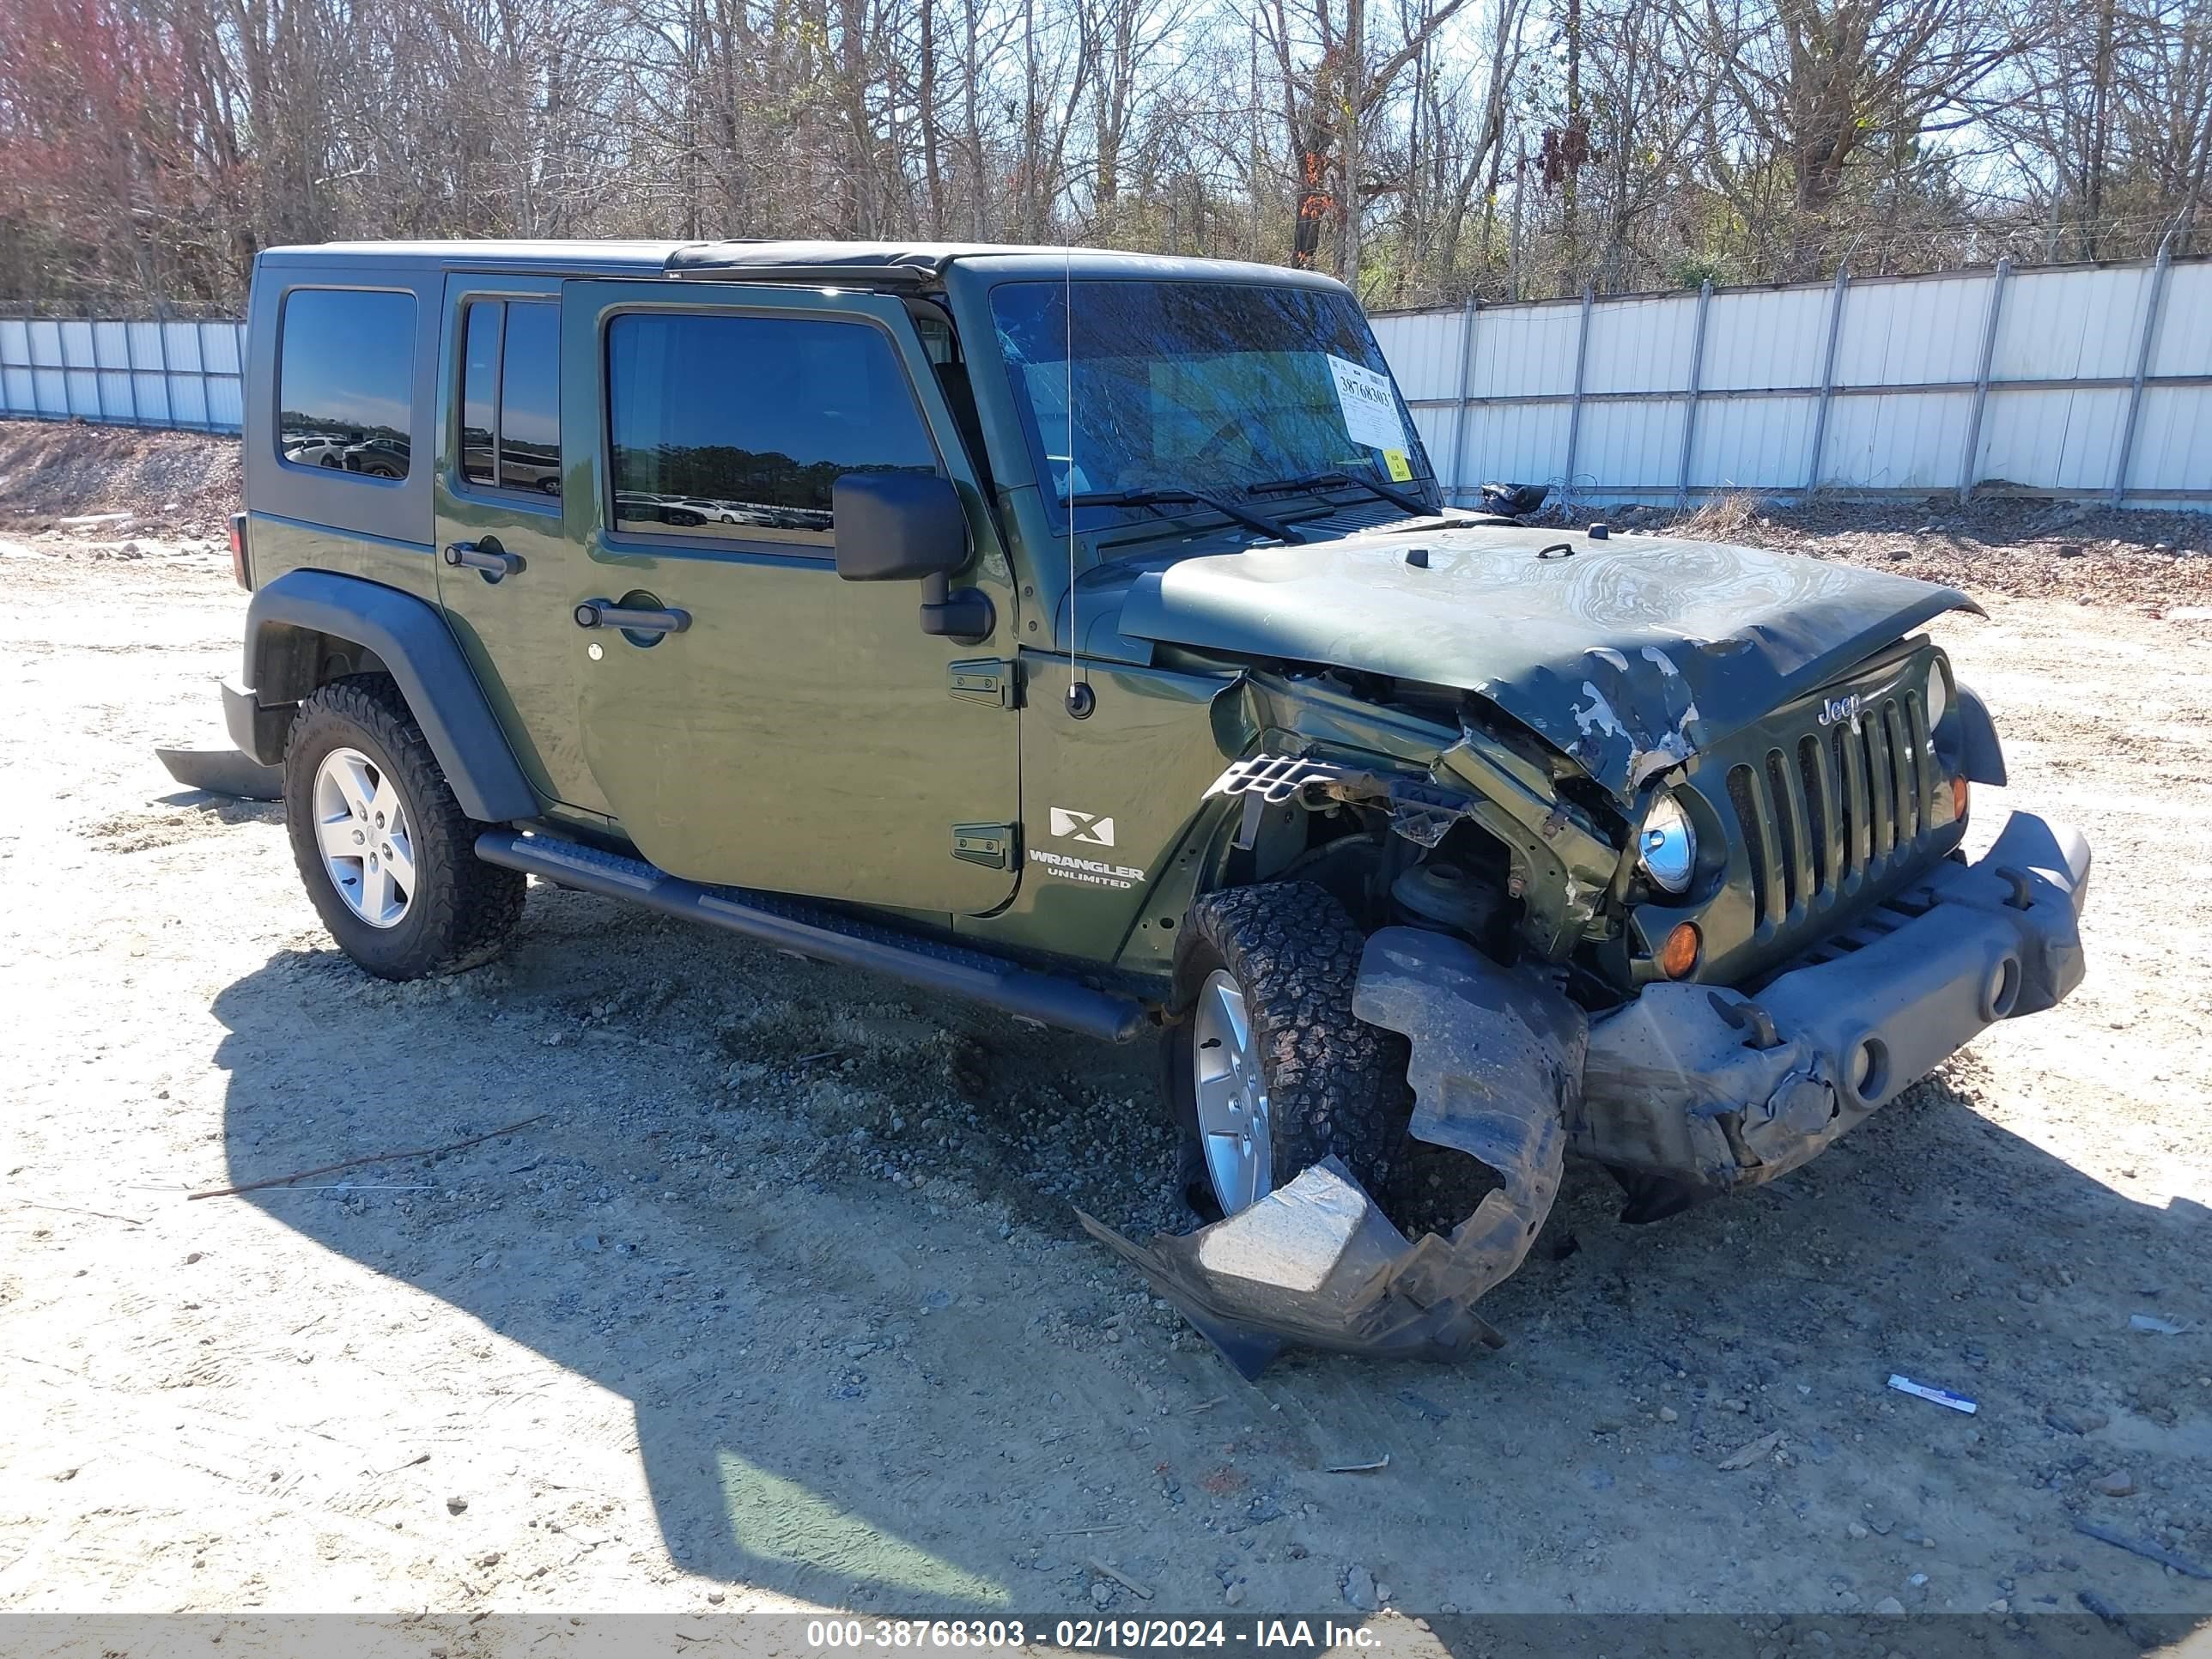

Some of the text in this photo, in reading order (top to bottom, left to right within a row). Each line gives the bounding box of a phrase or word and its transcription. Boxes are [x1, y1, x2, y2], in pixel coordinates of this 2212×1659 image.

[1818, 693, 1861, 726] Jeep
[1030, 849, 1146, 882] WRANGLER
[1048, 867, 1132, 889] UNLIMITED
